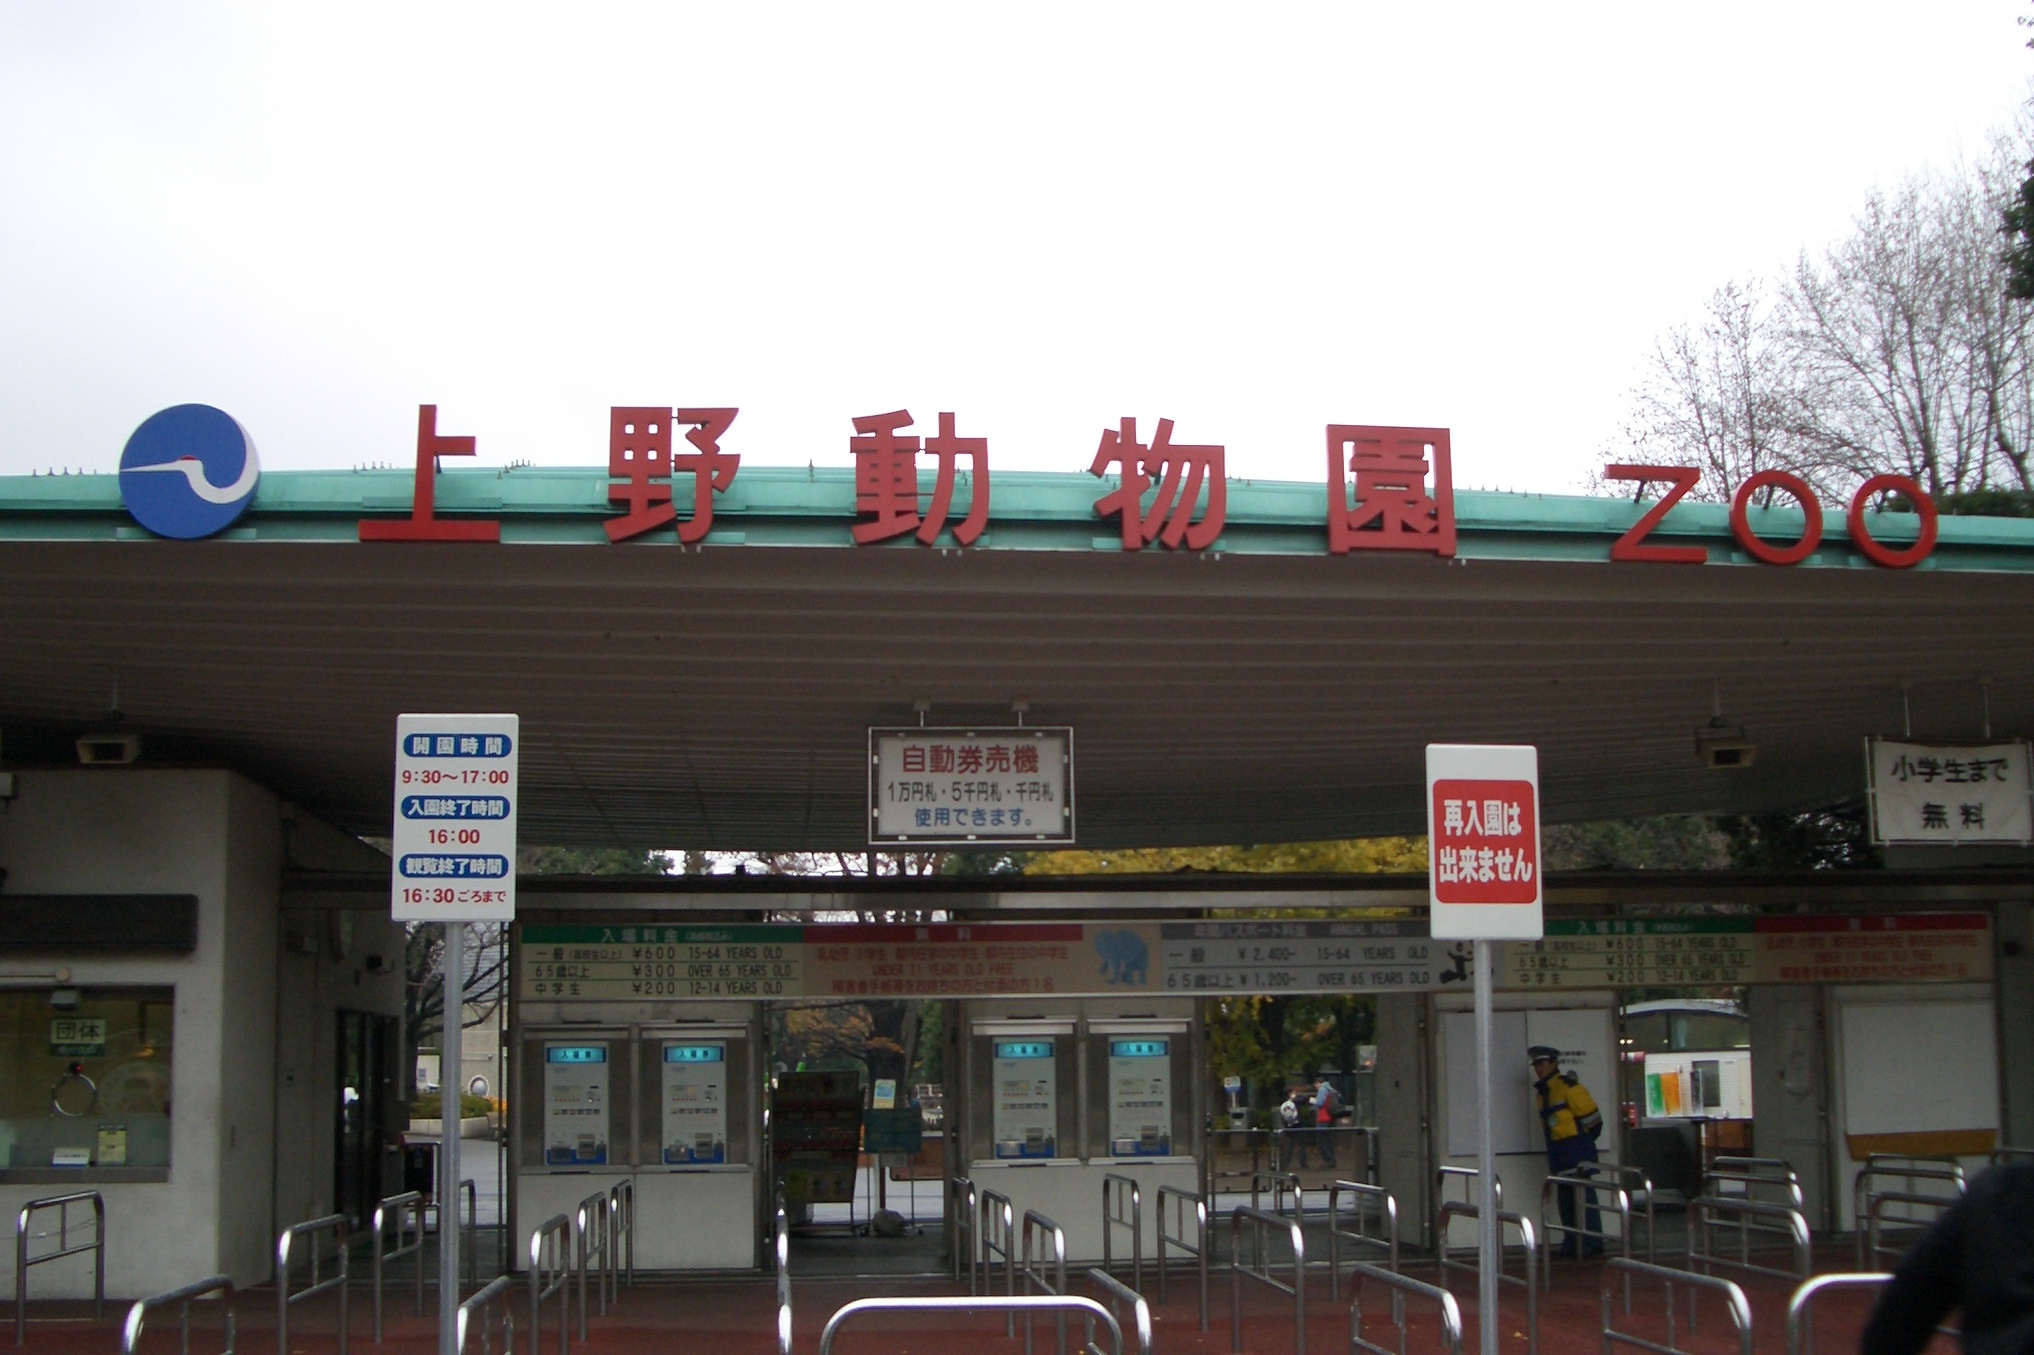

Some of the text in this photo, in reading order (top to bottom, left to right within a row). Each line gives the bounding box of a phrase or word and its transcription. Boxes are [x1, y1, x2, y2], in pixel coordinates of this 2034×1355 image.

[359, 404, 1938, 569] 上野動物園 ZOO
[412, 737, 502, 755] 開園時間
[902, 744, 1040, 774] 自動券売機
[1891, 755, 2009, 783] 小学生まで
[407, 799, 504, 816] 入園終了時間
[1922, 802, 1985, 830] 無料
[914, 807, 1033, 826] 使用できます。
[1444, 799, 1522, 836] 再入園は
[428, 829, 480, 844] 16:00
[406, 858, 503, 875] 観覧終了時間
[1439, 845, 1533, 883] 出来ません
[726, 946, 757, 960] YEARS
[763, 946, 782, 959] OLD
[1362, 946, 1396, 960] YEARS
[1408, 946, 1429, 959] OLD
[737, 963, 767, 977] YEARS
[773, 963, 791, 977] OLD
[1371, 971, 1403, 985] YEARS
[1409, 971, 1430, 984] OLD
[726, 981, 757, 994] YEARS
[763, 980, 782, 994] OLD
